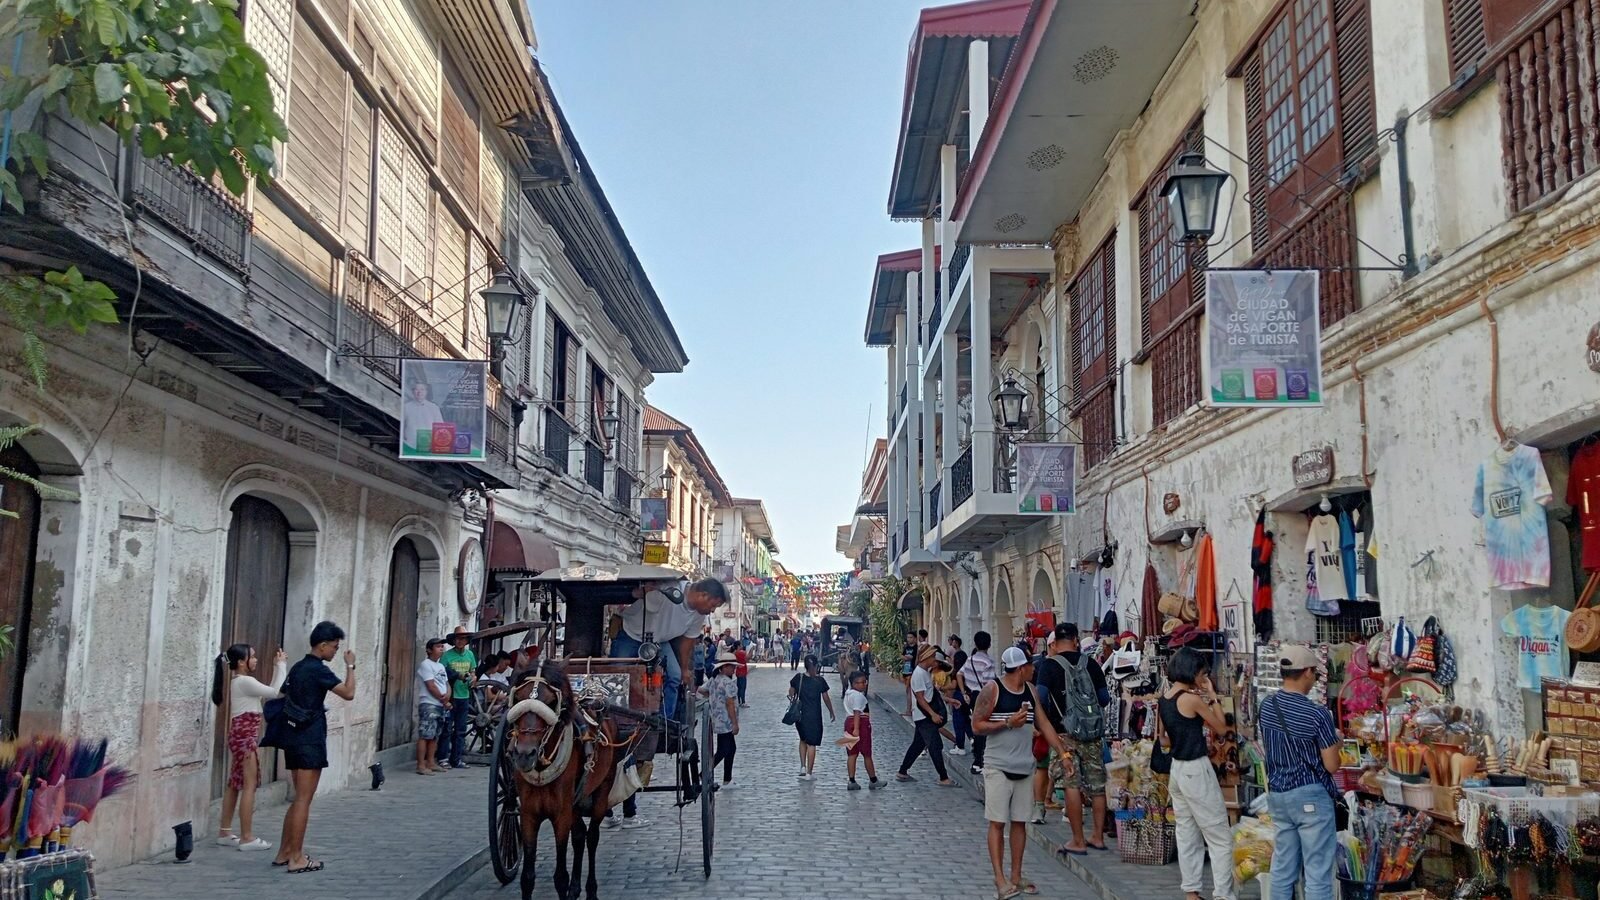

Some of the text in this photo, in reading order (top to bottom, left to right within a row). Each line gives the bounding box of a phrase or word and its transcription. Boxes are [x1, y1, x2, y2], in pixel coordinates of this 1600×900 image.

[1237, 298, 1289, 311] CIUDAD
[1230, 310, 1297, 322] de VIGAN
[1226, 322, 1300, 334] PASAPORTE
[1228, 333, 1299, 345] de TURISTA
[1224, 607, 1236, 628] NO
[1519, 634, 1551, 654] Vigan
